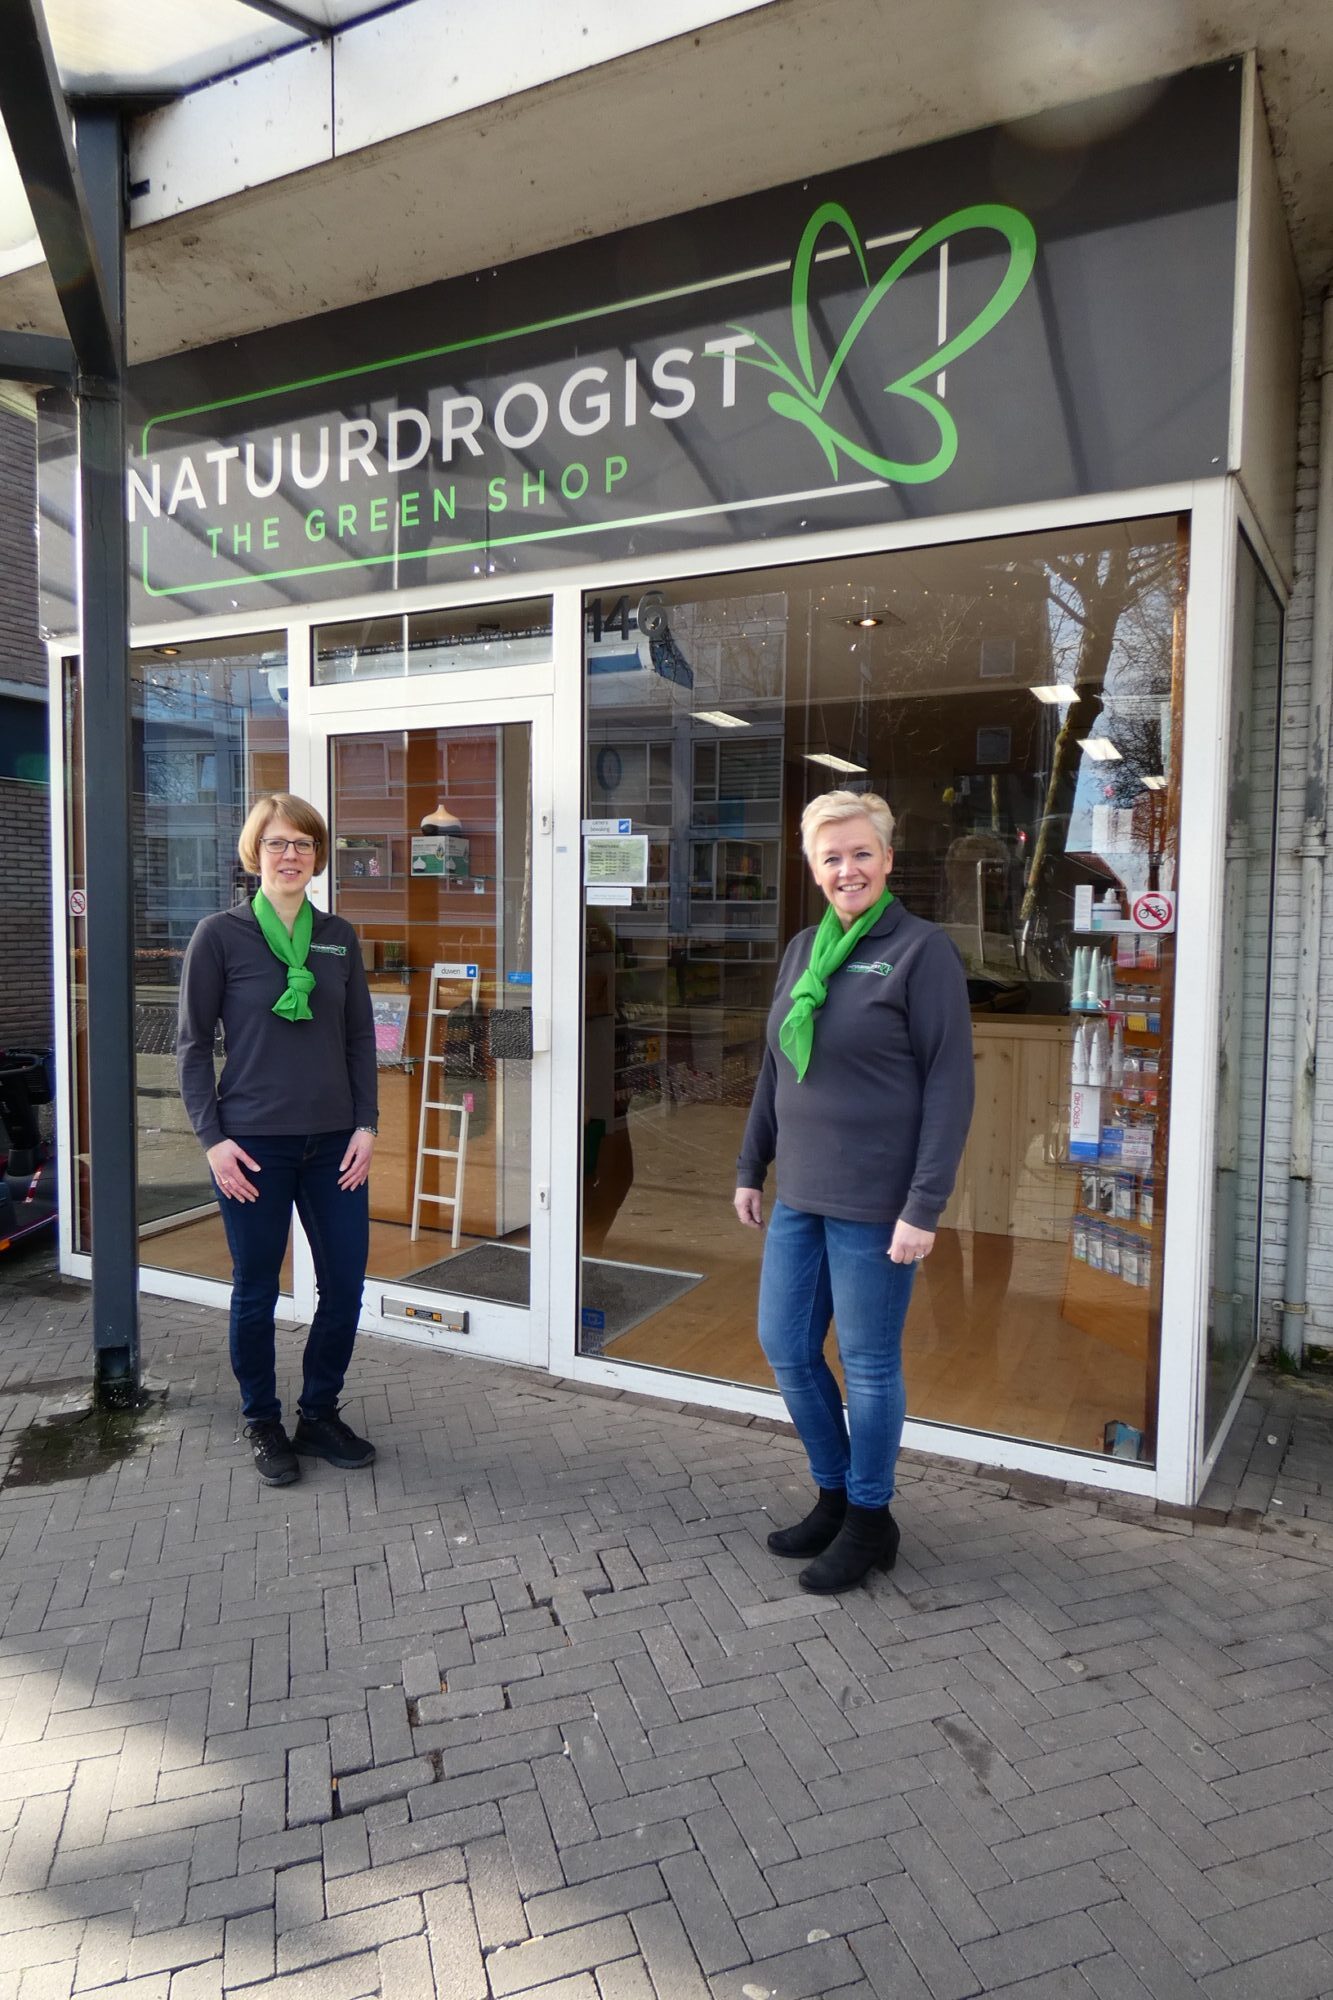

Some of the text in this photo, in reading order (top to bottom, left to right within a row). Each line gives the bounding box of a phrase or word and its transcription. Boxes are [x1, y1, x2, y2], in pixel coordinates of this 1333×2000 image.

[127, 333, 756, 523] NATUURDROGIST
[206, 455, 629, 558] THE GREEN SHOP
[584, 590, 668, 643] 146
[441, 967, 461, 975] duwen
